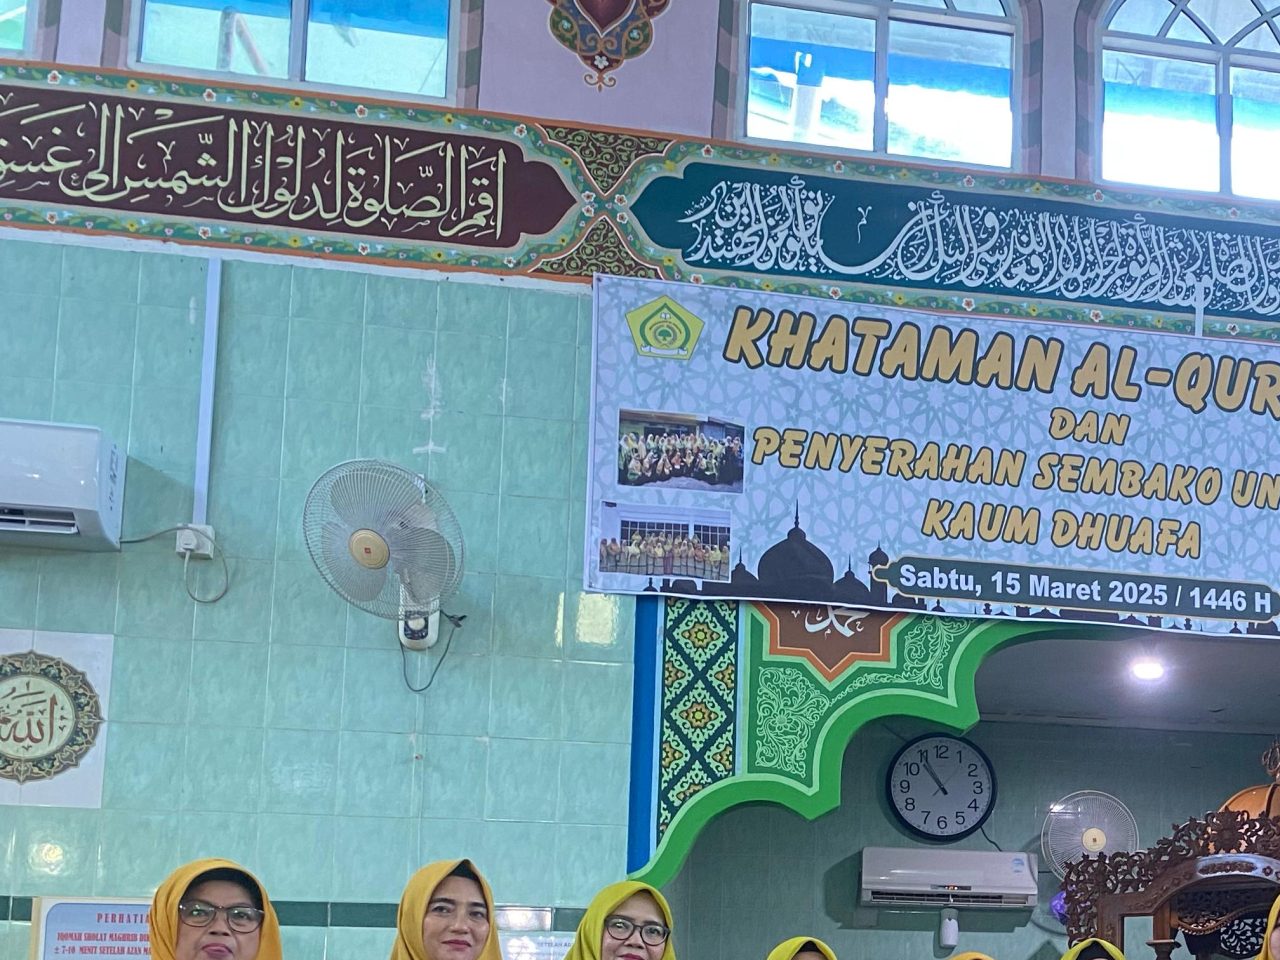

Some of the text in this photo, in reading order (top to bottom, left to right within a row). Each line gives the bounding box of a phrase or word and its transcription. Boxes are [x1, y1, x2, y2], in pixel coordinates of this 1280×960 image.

[723, 305, 1063, 394] KHATAMAN
[1048, 406, 1131, 447] DAN
[751, 426, 1027, 490] PENYERAHAN
[1033, 451, 1222, 506] SEMBAKO
[921, 498, 1202, 560] KAUM DHUAFA
[900, 565, 1271, 613] Sabtu, 15 Maret 2025 / 1446 H
[934, 745, 949, 759] 12
[903, 762, 920, 776] 10
[967, 764, 978, 777] 2
[900, 780, 910, 793] 9
[973, 781, 983, 795] 3
[904, 797, 916, 811] 8
[967, 799, 979, 812] 4
[921, 811, 931, 824] 7
[937, 816, 948, 829] 6
[955, 812, 965, 825] 5
